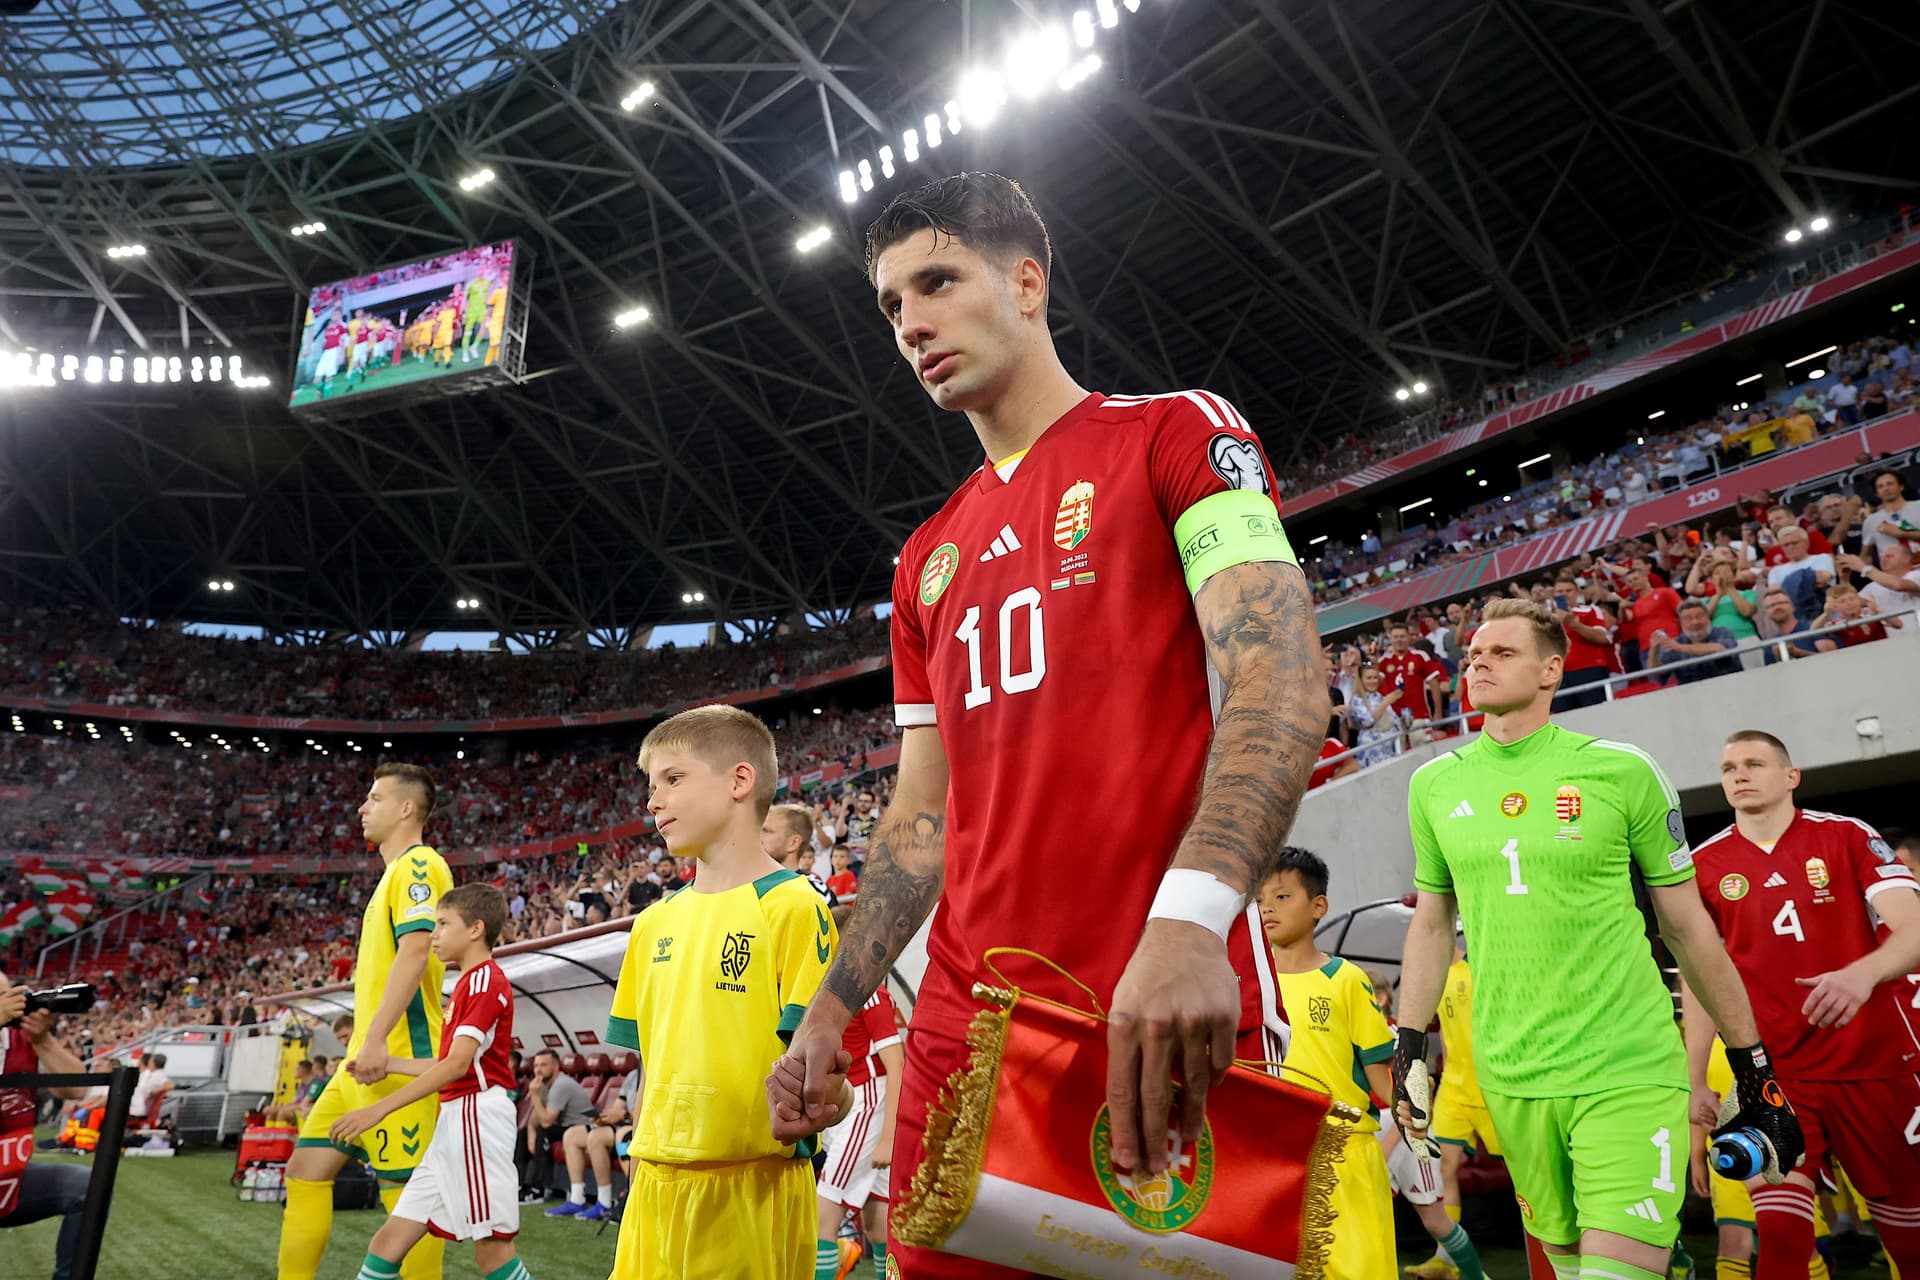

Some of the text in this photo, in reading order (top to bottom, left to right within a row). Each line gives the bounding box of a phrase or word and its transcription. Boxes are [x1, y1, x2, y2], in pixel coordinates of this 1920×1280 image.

[1687, 488, 1720, 508] 120
[1060, 560, 1089, 573] BUDAPEST
[954, 586, 1047, 711] 10
[1500, 838, 1528, 895] 1
[1772, 900, 1805, 942] 4
[715, 981, 746, 993] LIETUVA
[1445, 996, 1454, 1018] 6
[376, 1128, 389, 1163] 2
[1650, 1127, 1675, 1193] 1
[1133, 1207, 1168, 1228] 1901
